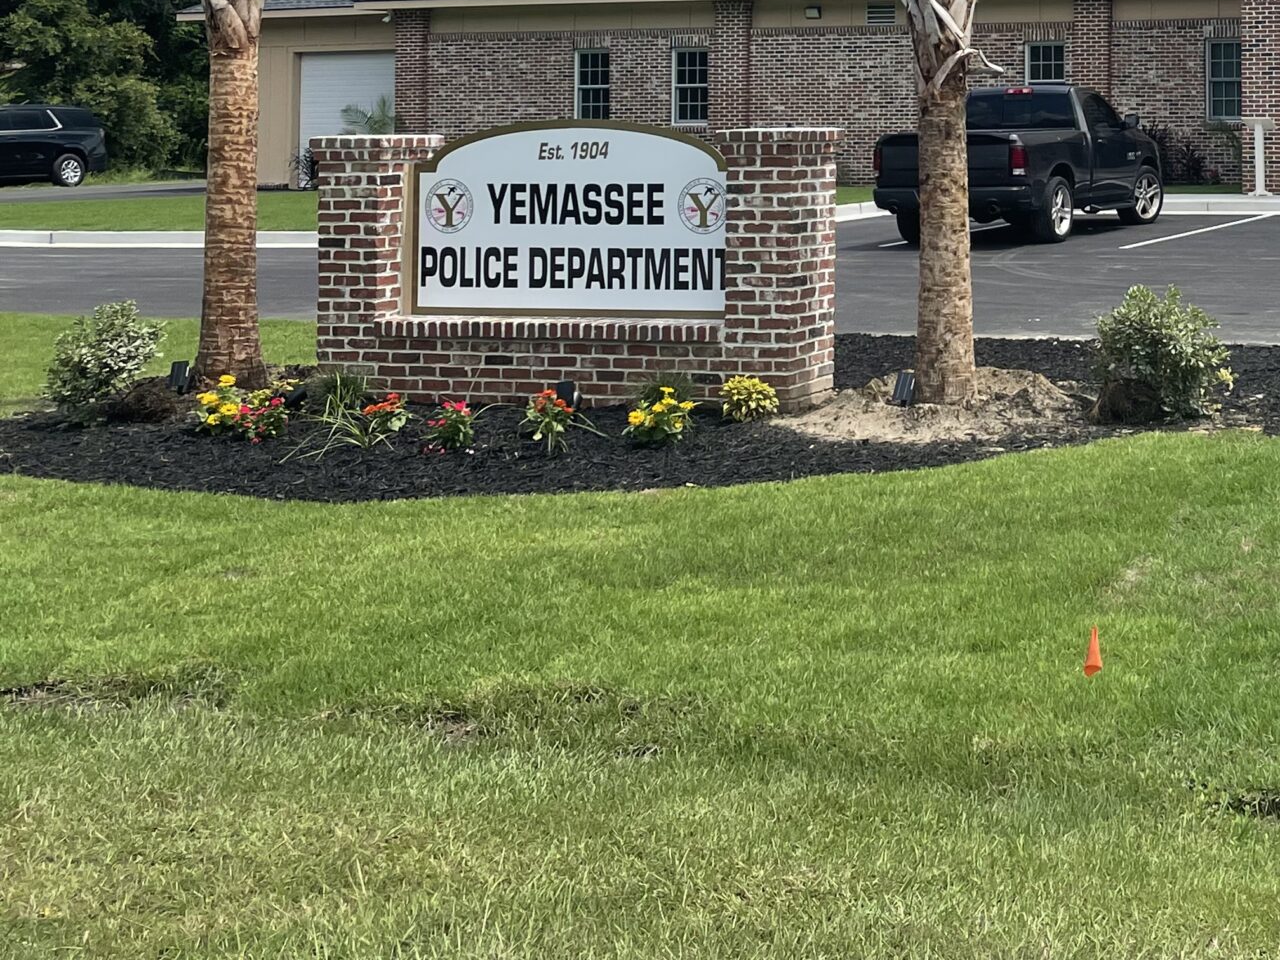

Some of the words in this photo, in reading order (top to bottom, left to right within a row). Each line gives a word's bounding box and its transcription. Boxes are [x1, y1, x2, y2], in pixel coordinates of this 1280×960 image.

[538, 142, 564, 160] Est.
[570, 141, 609, 160] 1904
[433, 193, 465, 227] Y
[487, 183, 665, 225] YEMASSEE
[687, 193, 720, 227] Y
[420, 246, 518, 288] POLICE
[529, 247, 726, 291] DEPARTMENT
